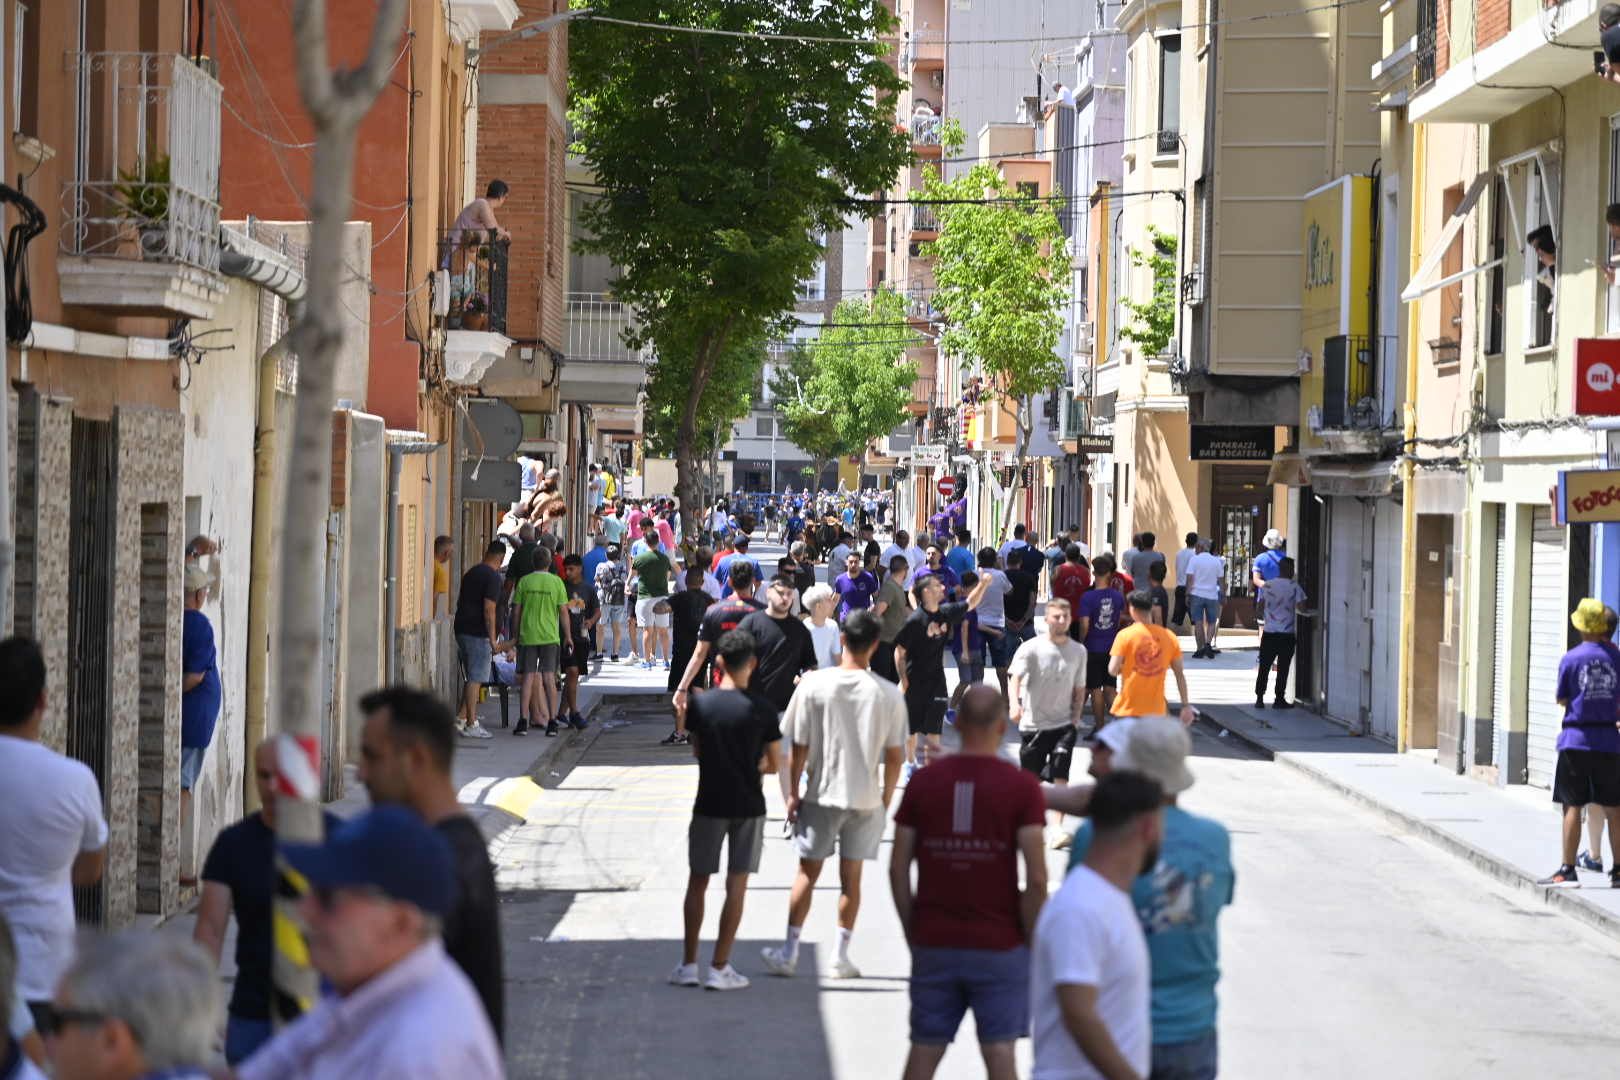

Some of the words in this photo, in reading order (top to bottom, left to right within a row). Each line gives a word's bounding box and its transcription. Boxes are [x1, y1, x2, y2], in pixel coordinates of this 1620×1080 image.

[1209, 441, 1257, 449] PAPARAZZI
[1199, 449, 1217, 457] BAR
[1219, 449, 1268, 457] BOCATERIA
